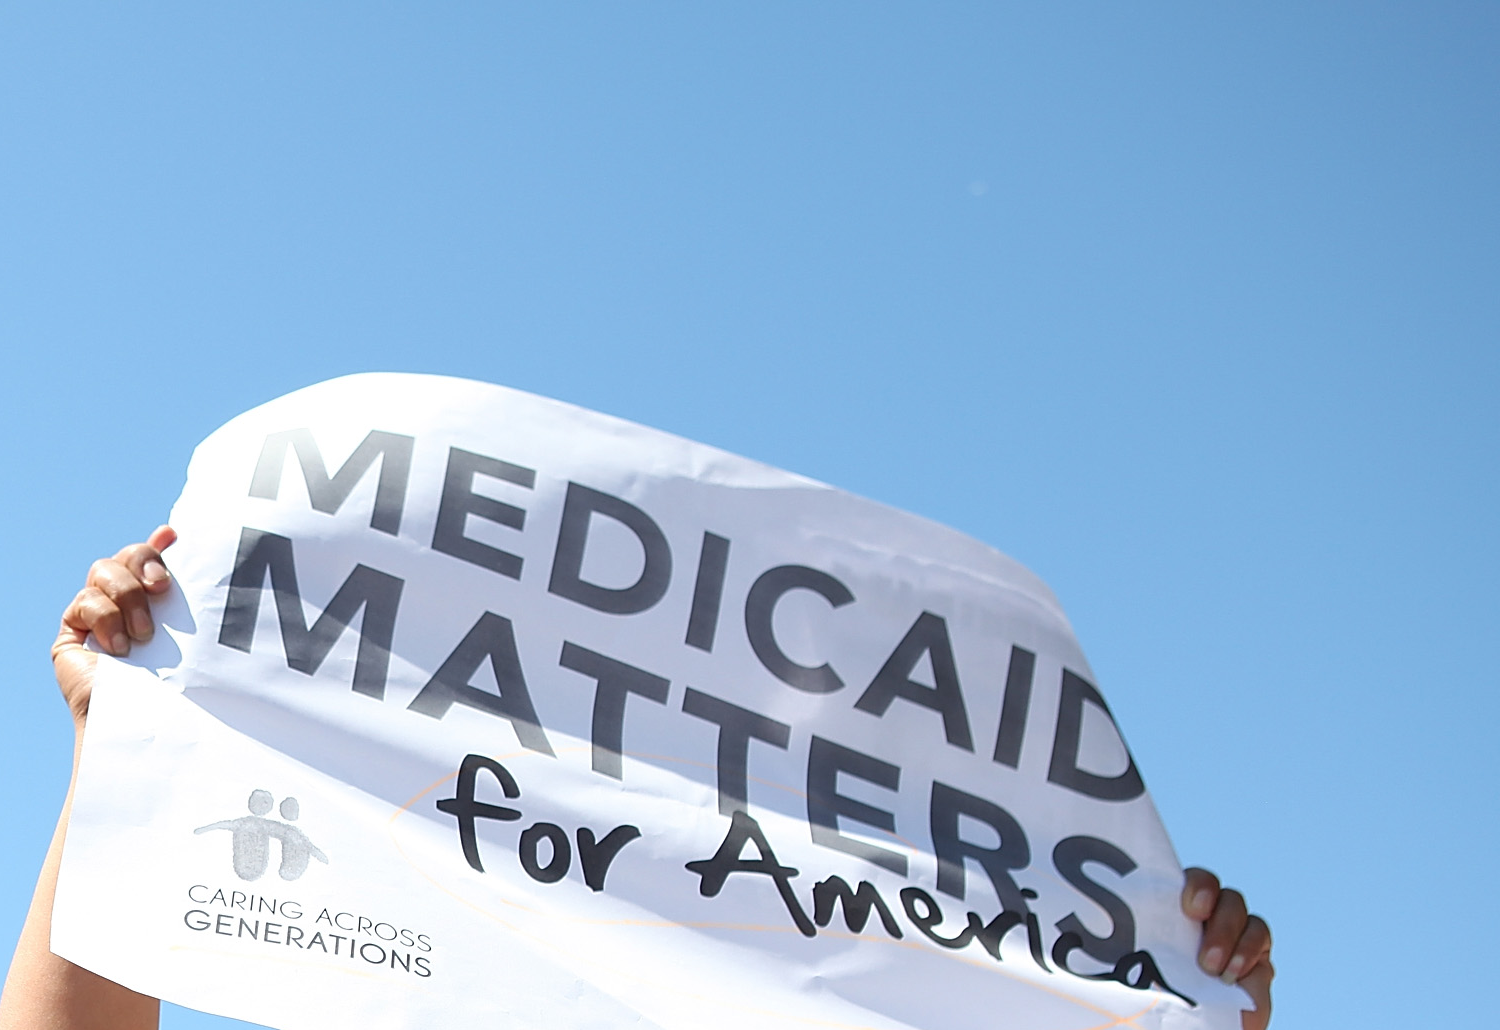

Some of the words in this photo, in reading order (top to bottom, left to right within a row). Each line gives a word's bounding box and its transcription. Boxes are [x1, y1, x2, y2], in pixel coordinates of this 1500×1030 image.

[248, 427, 1146, 802] MEDICAID
[218, 526, 1138, 964] MATTERS
[183, 909, 433, 978] GENERATIONS
[188, 884, 303, 920] CARING
[315, 907, 433, 953] ACROSS
[436, 754, 642, 893] for
[684, 811, 1198, 1008] America
